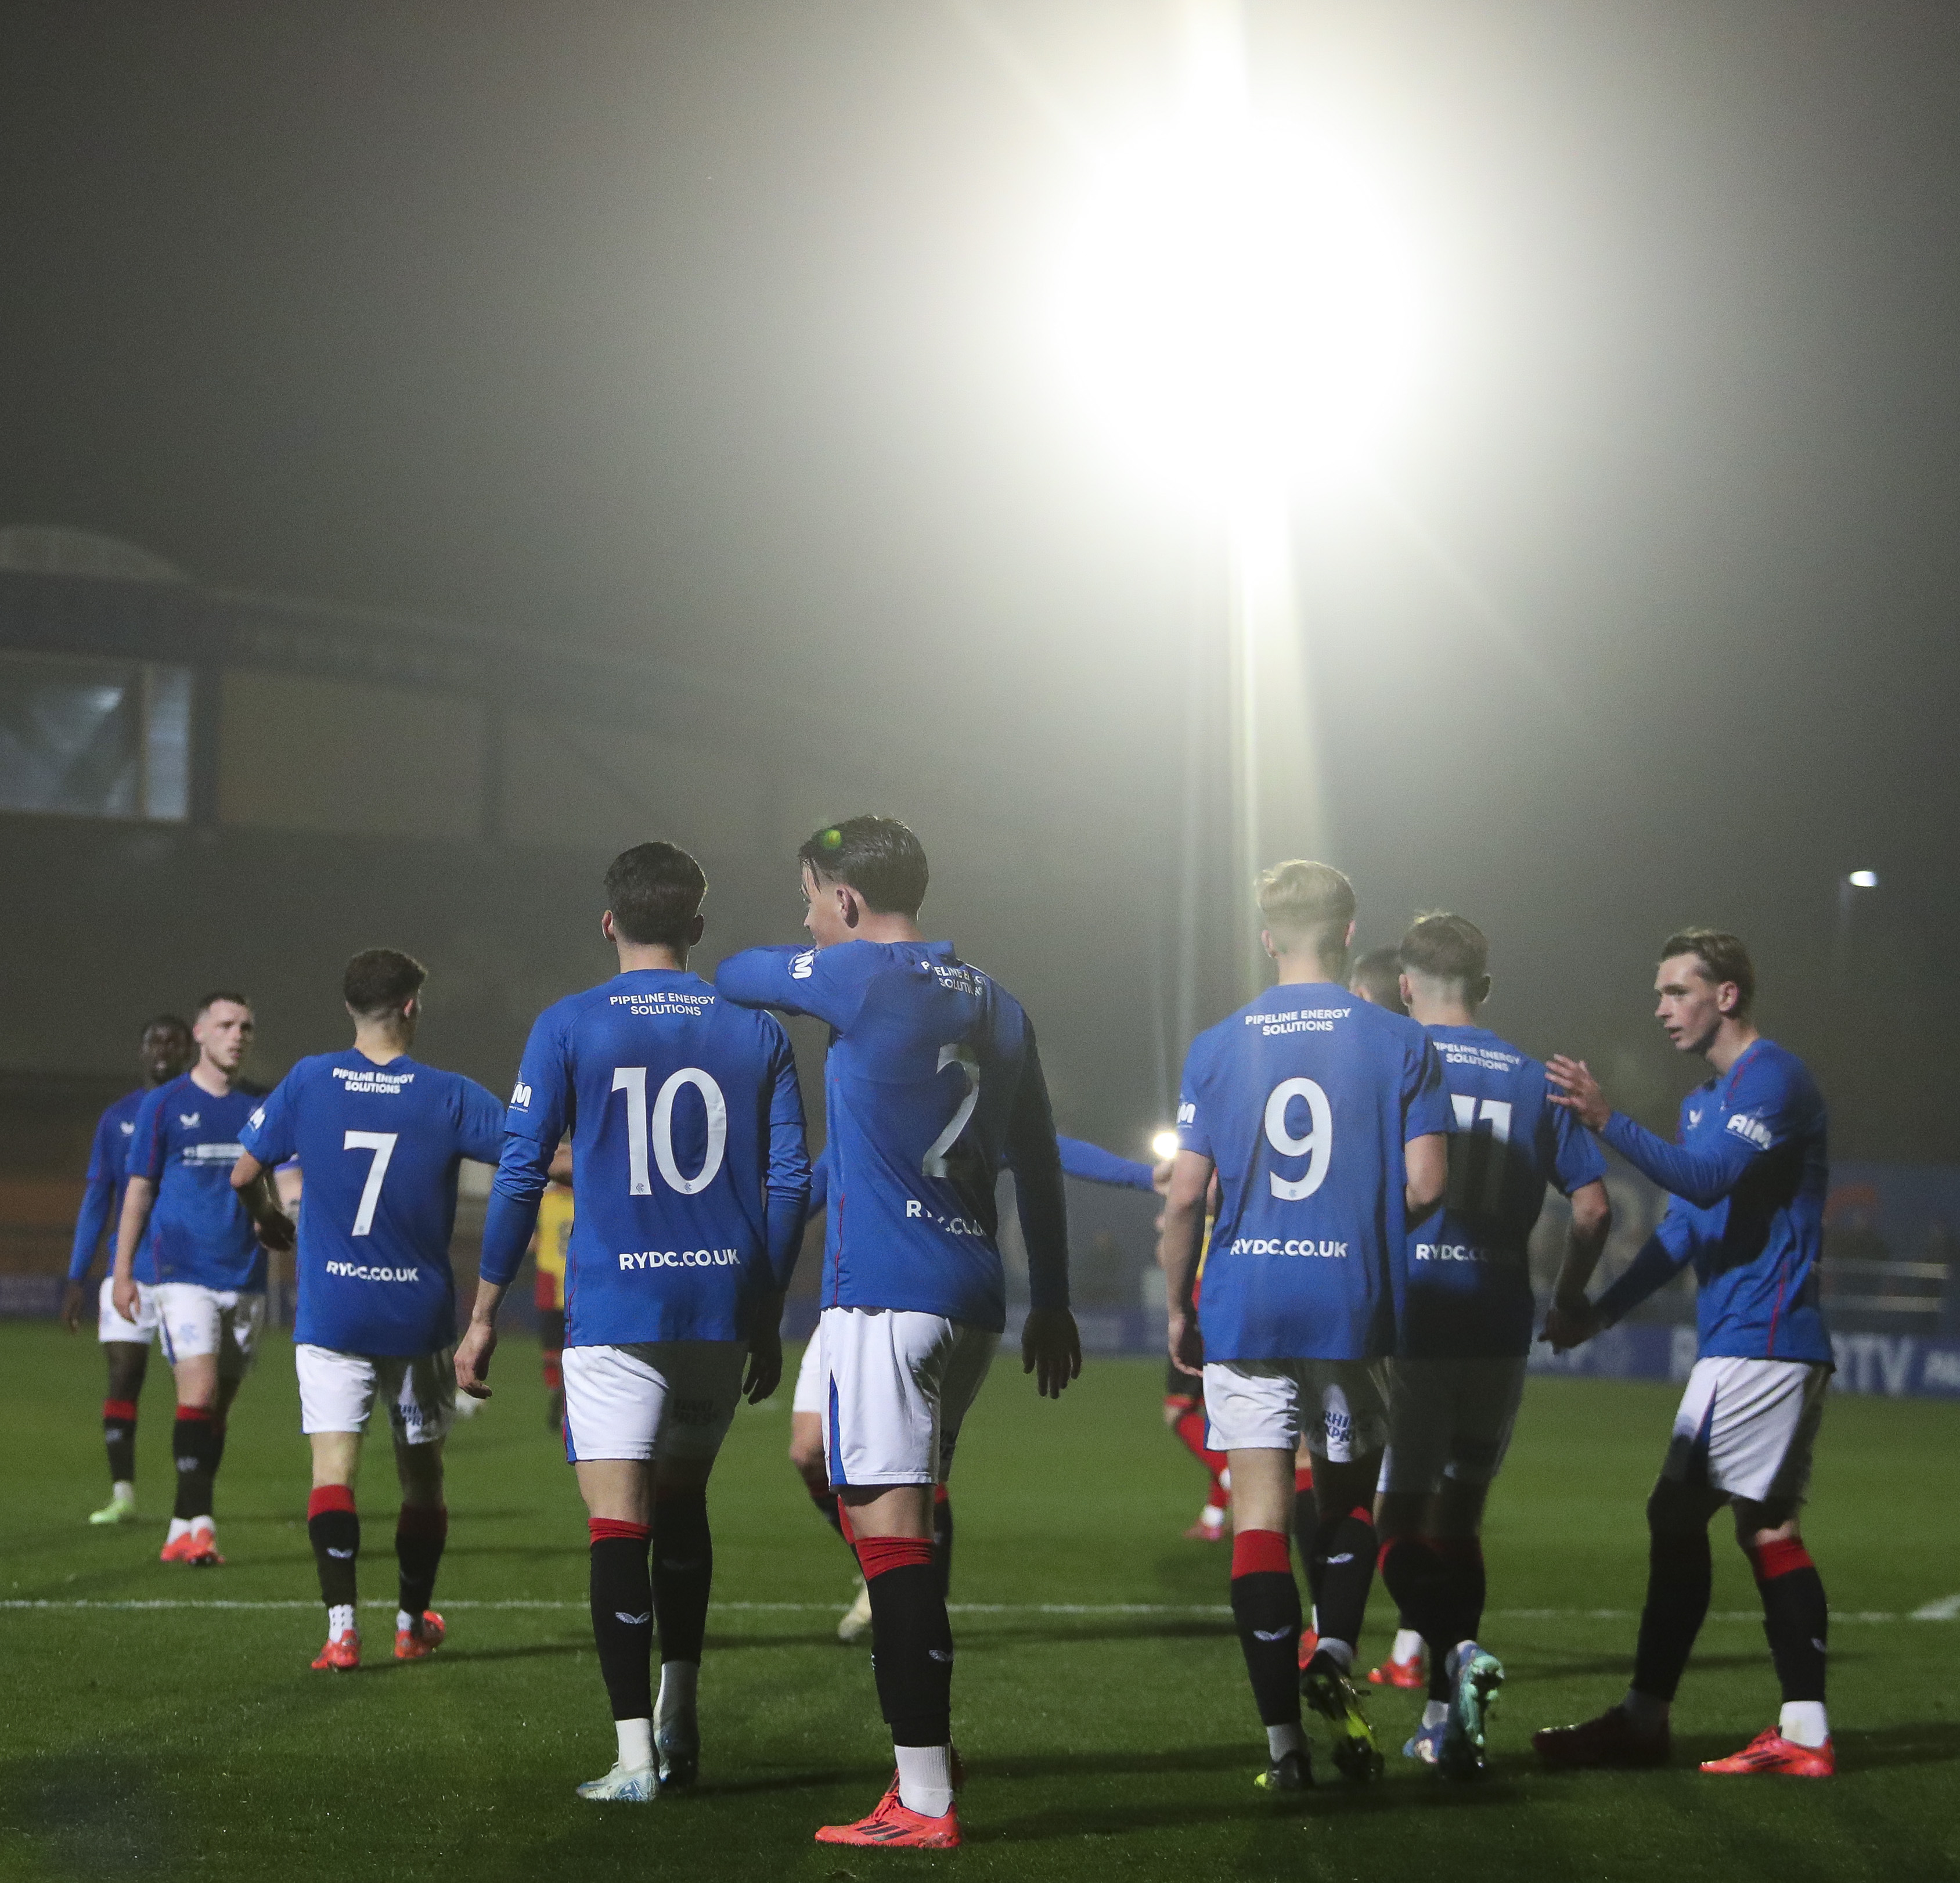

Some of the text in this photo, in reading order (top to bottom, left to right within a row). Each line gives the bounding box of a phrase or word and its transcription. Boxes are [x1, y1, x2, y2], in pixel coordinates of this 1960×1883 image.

[610, 992, 715, 1005] PIPELINE ENERGY
[630, 1004, 701, 1016] SOLUTIONS
[1245, 1008, 1351, 1025] PIPELINE ENERGY
[1263, 1021, 1334, 1036] SOLUTIONS
[1446, 1053, 1509, 1072] SOLUTIONS
[332, 1067, 415, 1083] PIPELINE ENERGY
[345, 1081, 401, 1094] SOLUTIONS
[921, 1043, 982, 1179] 2
[611, 1067, 727, 1196] 10
[1264, 1077, 1333, 1201] 9
[343, 1130, 398, 1236] 7
[1230, 1238, 1348, 1258] RYDC.CO.UK
[619, 1249, 740, 1270] RYDC.CO.UK
[326, 1260, 419, 1282] RYDC.CO.UK
